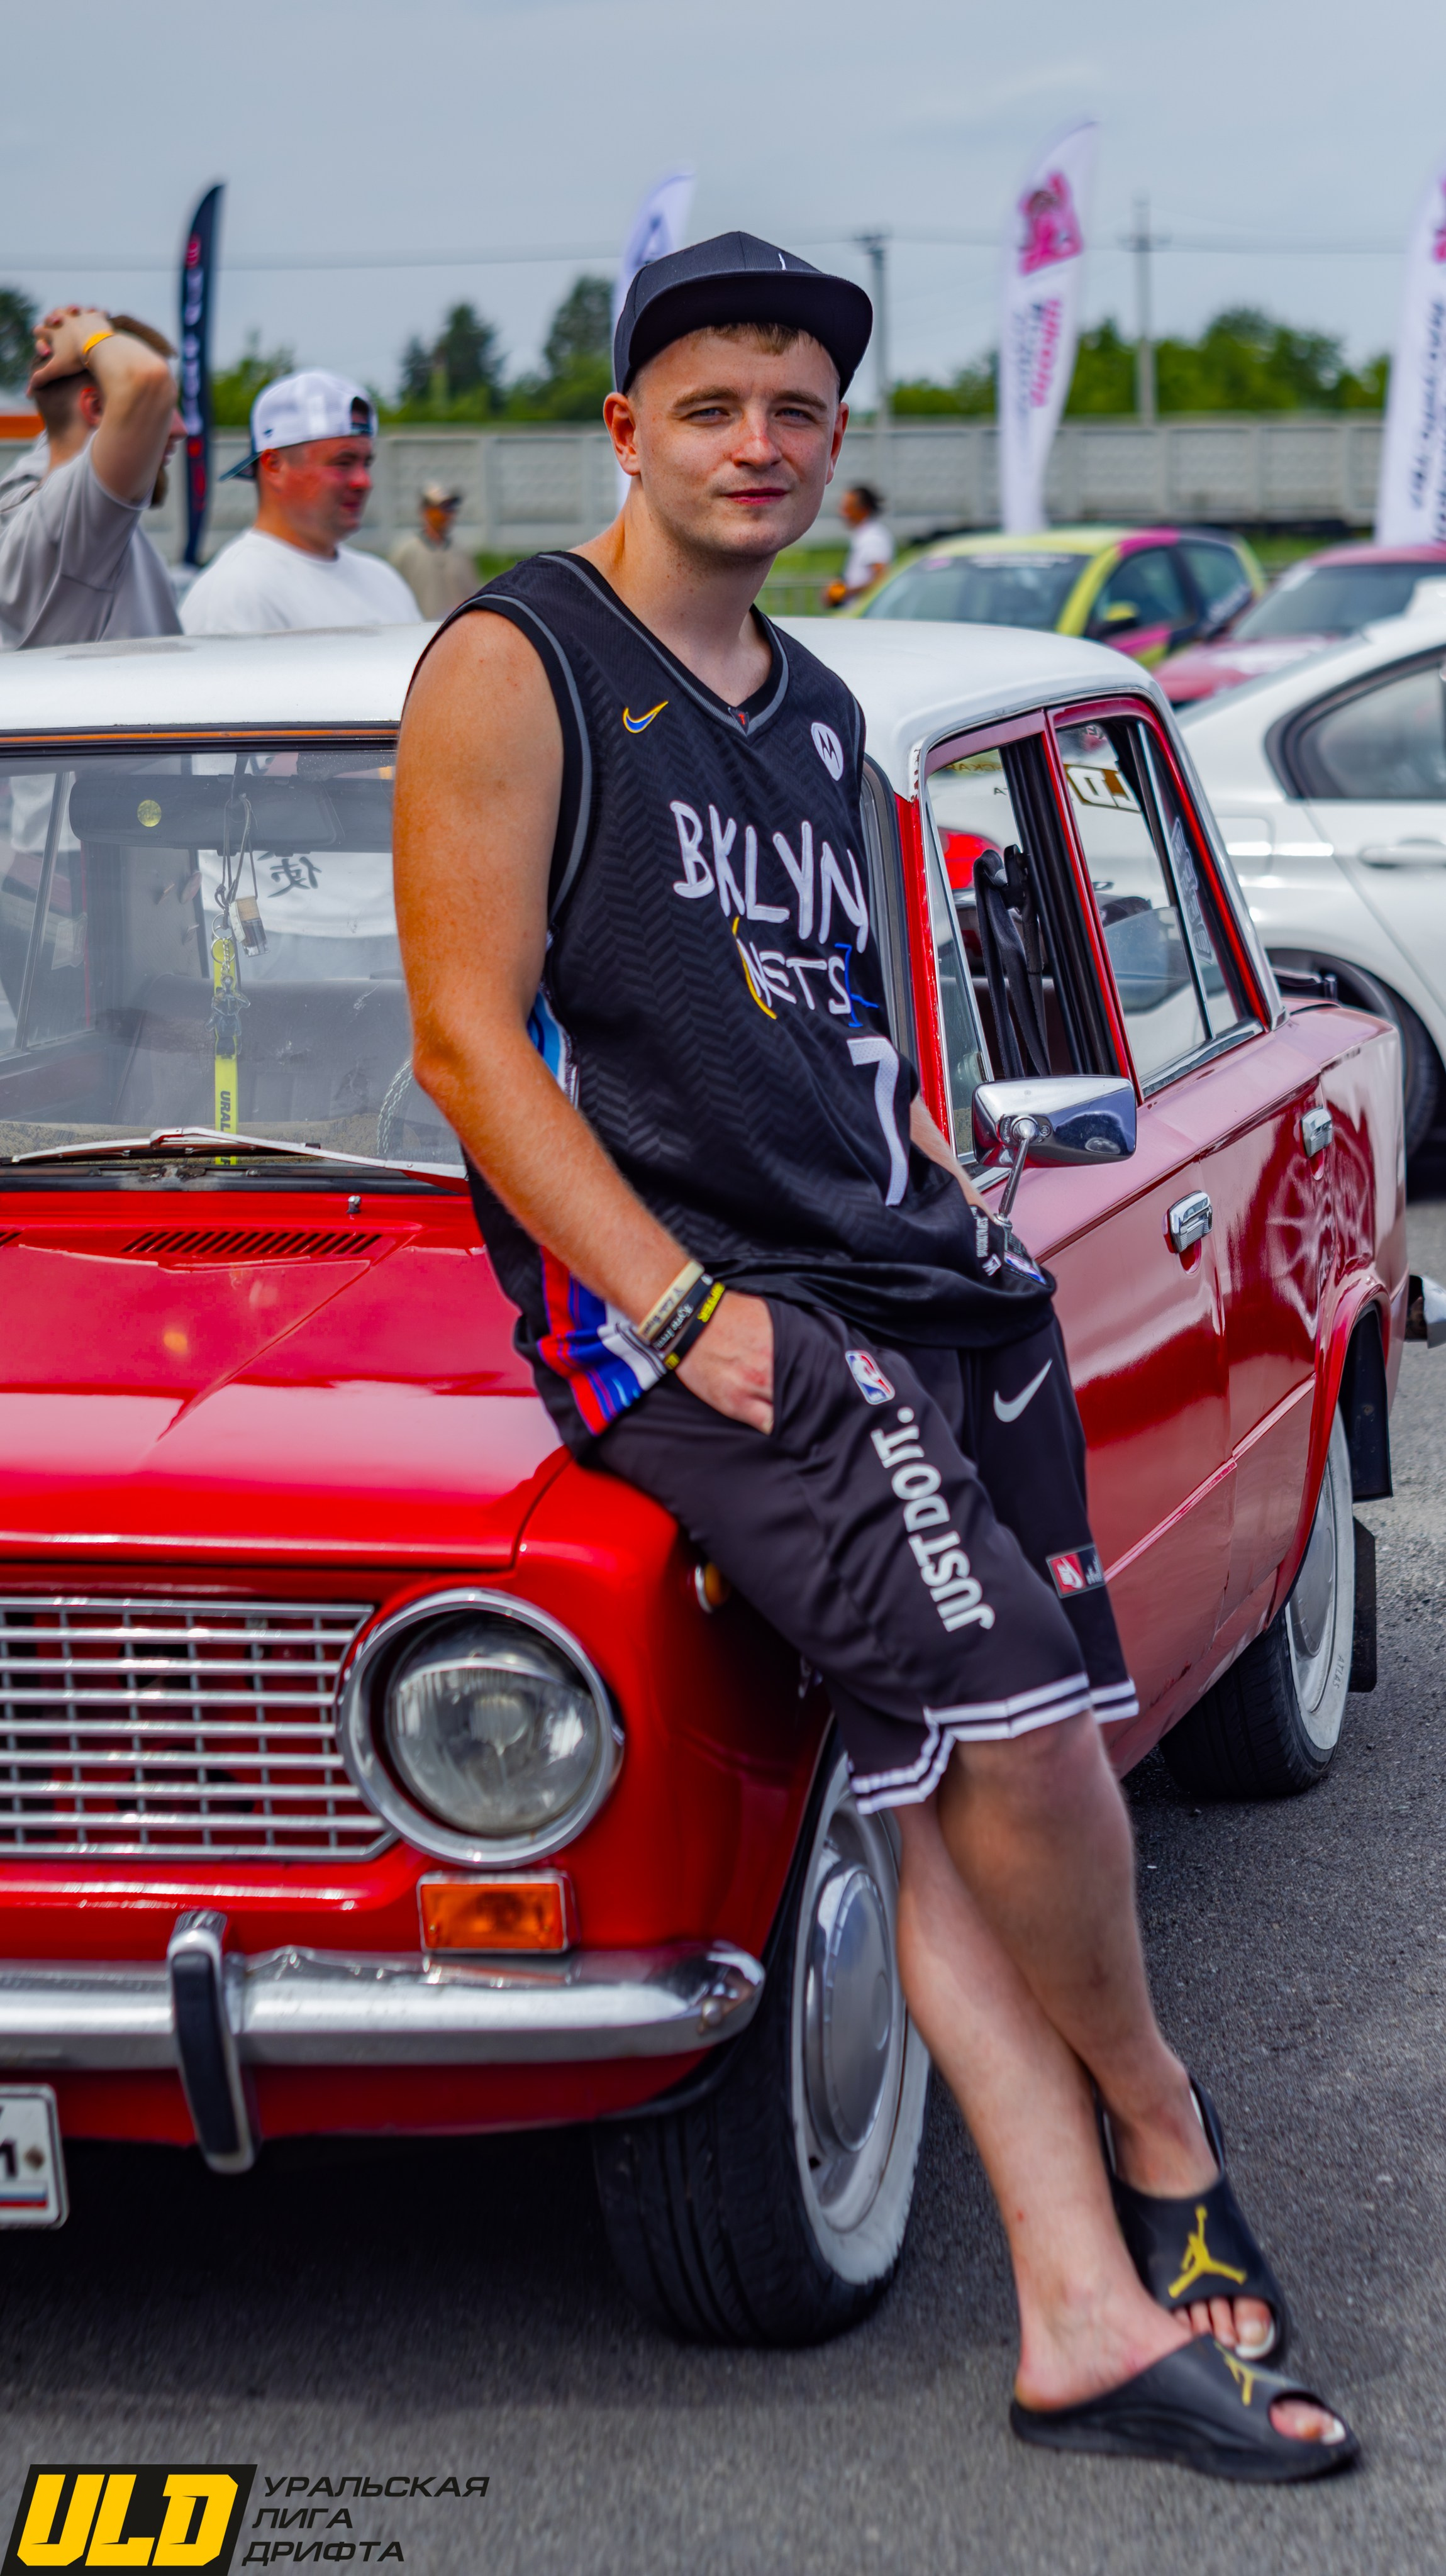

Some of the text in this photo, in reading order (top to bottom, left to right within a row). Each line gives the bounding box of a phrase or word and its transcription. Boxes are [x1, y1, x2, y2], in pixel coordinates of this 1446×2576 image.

[670, 800, 869, 953] BKLYN
[735, 938, 851, 1014] NETS
[1191, 929, 1211, 955] CLUB
[220, 1090, 231, 1131] URAL
[847, 1036, 908, 1206] 7
[870, 1407, 995, 1632] JUST DO IT.
[1333, 1655, 1345, 1689] ATLAS
